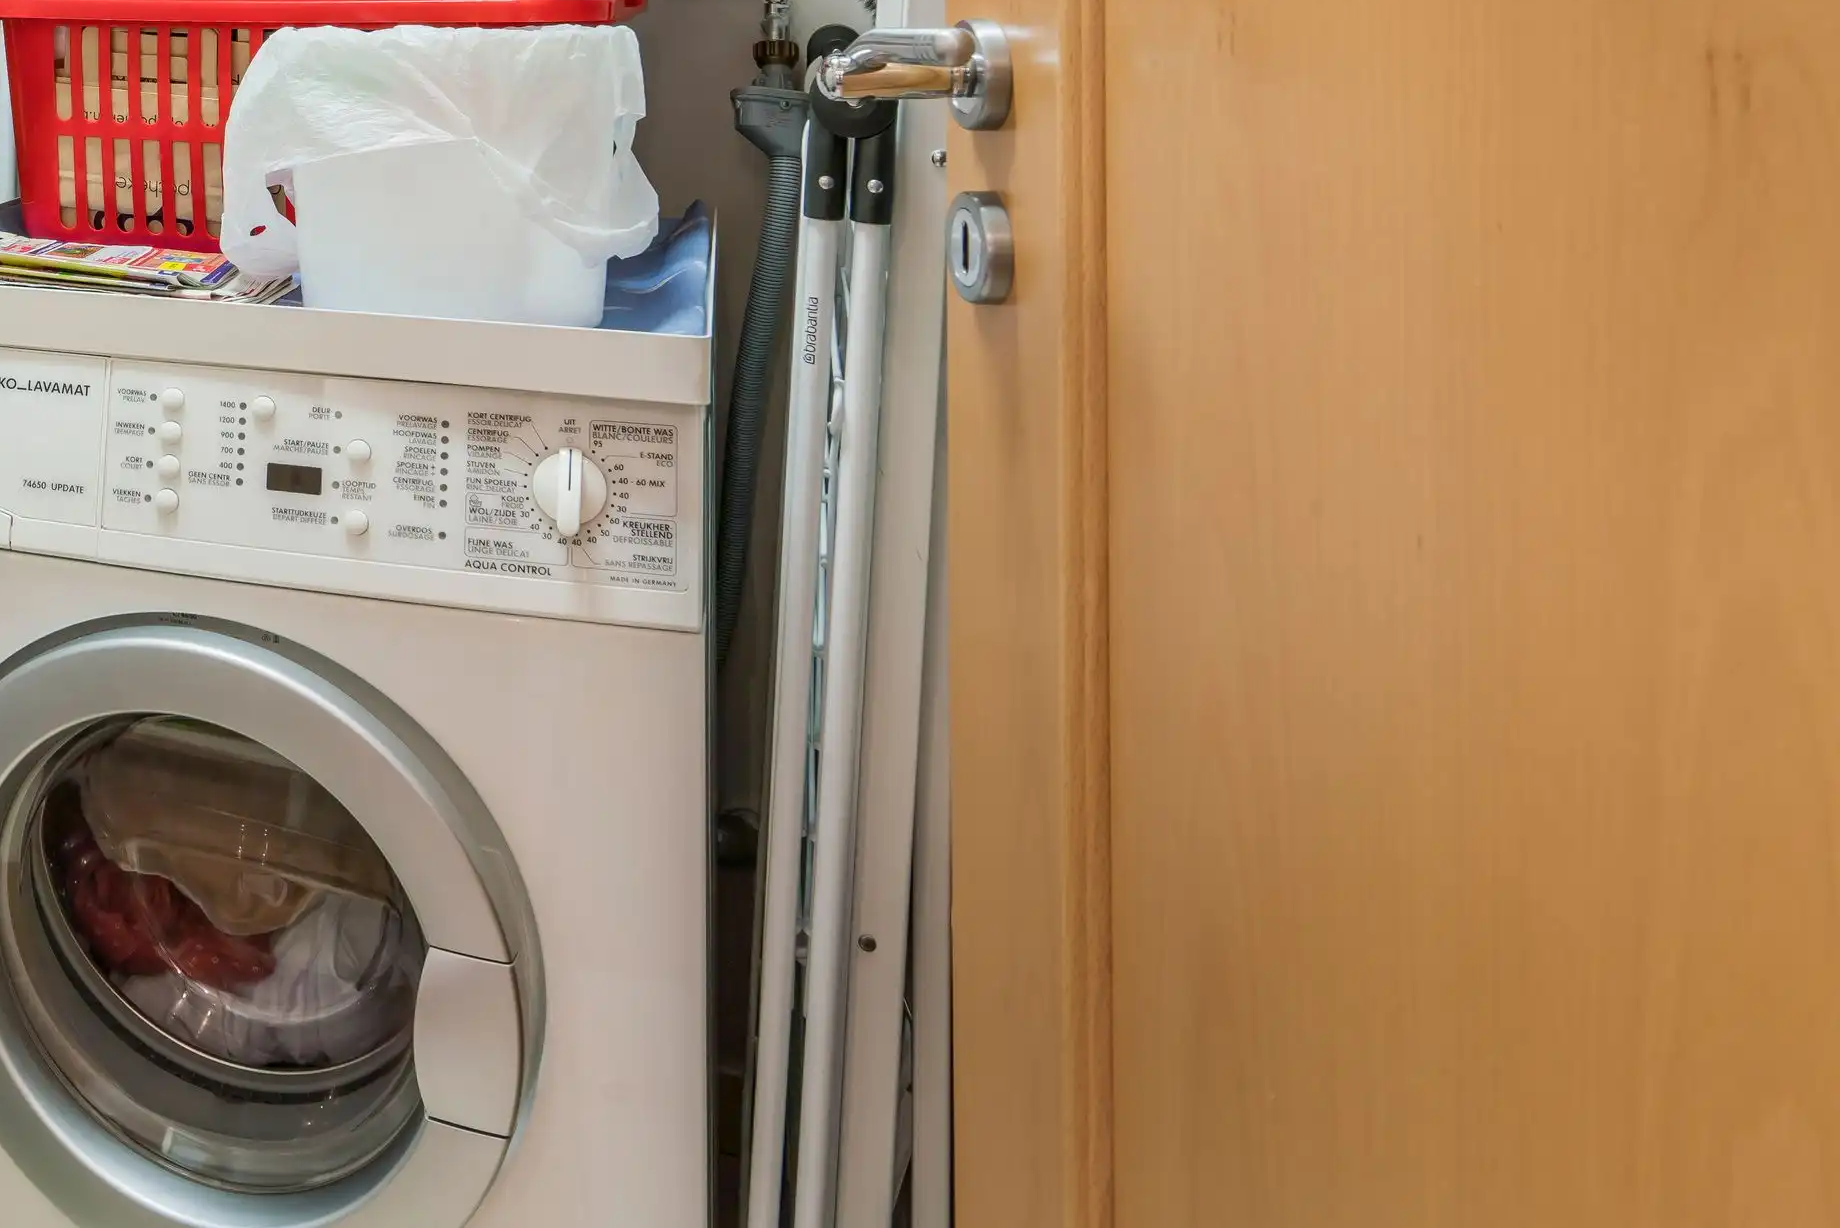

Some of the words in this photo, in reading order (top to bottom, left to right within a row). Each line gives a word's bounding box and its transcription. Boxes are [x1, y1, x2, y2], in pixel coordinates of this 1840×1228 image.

[803, 296, 819, 352] brabantia
[117, 388, 147, 397] VOORWAS
[220, 401, 236, 409] 1400
[312, 406, 331, 414] DEUR
[219, 416, 235, 424] 1200
[308, 413, 331, 421] PORTE
[399, 415, 438, 424] VOORWAS
[467, 411, 487, 420] KORT
[115, 421, 145, 430] INWEKEN
[220, 431, 235, 439] 900
[392, 429, 437, 439] HOOFDWAS
[592, 424, 651, 435] WITTE/BONTE
[653, 427, 674, 437] WAS
[408, 437, 437, 446] LAVAGE
[467, 435, 509, 444] ESSORAGE
[592, 431, 674, 445] BLANC/COULEURS
[283, 439, 329, 450] START/PAUZE
[467, 444, 501, 453] POMPEN
[593, 440, 603, 448] 95
[220, 446, 234, 454] 700
[273, 444, 329, 456] MARCHE/PAUSE
[404, 446, 437, 455] SPOELEN
[125, 456, 143, 464] KORT
[640, 452, 674, 461] E-STAND
[120, 462, 143, 470] COURT
[396, 461, 429, 470] SPOELEN
[656, 460, 674, 468] ECO
[188, 471, 207, 479] GEEN
[188, 477, 207, 485] SANS
[484, 478, 518, 488] SPOELEN
[648, 480, 665, 488] MIX
[22, 479, 47, 491] 74650
[51, 481, 84, 494] UPDATE
[396, 483, 436, 493] ESSORAGE
[112, 488, 141, 497] VLEKKEN
[341, 492, 372, 502] RESTANT
[619, 492, 629, 500] 40
[413, 493, 436, 503] EINDE
[501, 495, 525, 503] KOUD
[422, 500, 436, 509] FIN
[501, 502, 525, 510] FROID
[616, 505, 627, 513] 30
[610, 517, 620, 525] 60
[529, 523, 540, 531] 40
[622, 521, 673, 532] KREUKHER-
[542, 532, 552, 540] 30
[600, 529, 610, 537] 50
[631, 529, 674, 540] STELLEND
[493, 540, 513, 549] WAS
[557, 537, 568, 546] 40
[571, 539, 582, 547] 40
[587, 536, 597, 544] 40
[612, 535, 674, 548] DEFROISSABLE
[464, 559, 498, 571] AQUA
[500, 562, 552, 576] CONTROL
[604, 560, 627, 568] SANS
[628, 561, 674, 572] REPASSAGE
[609, 576, 629, 584] MADE
[642, 578, 677, 587] GERMANY
